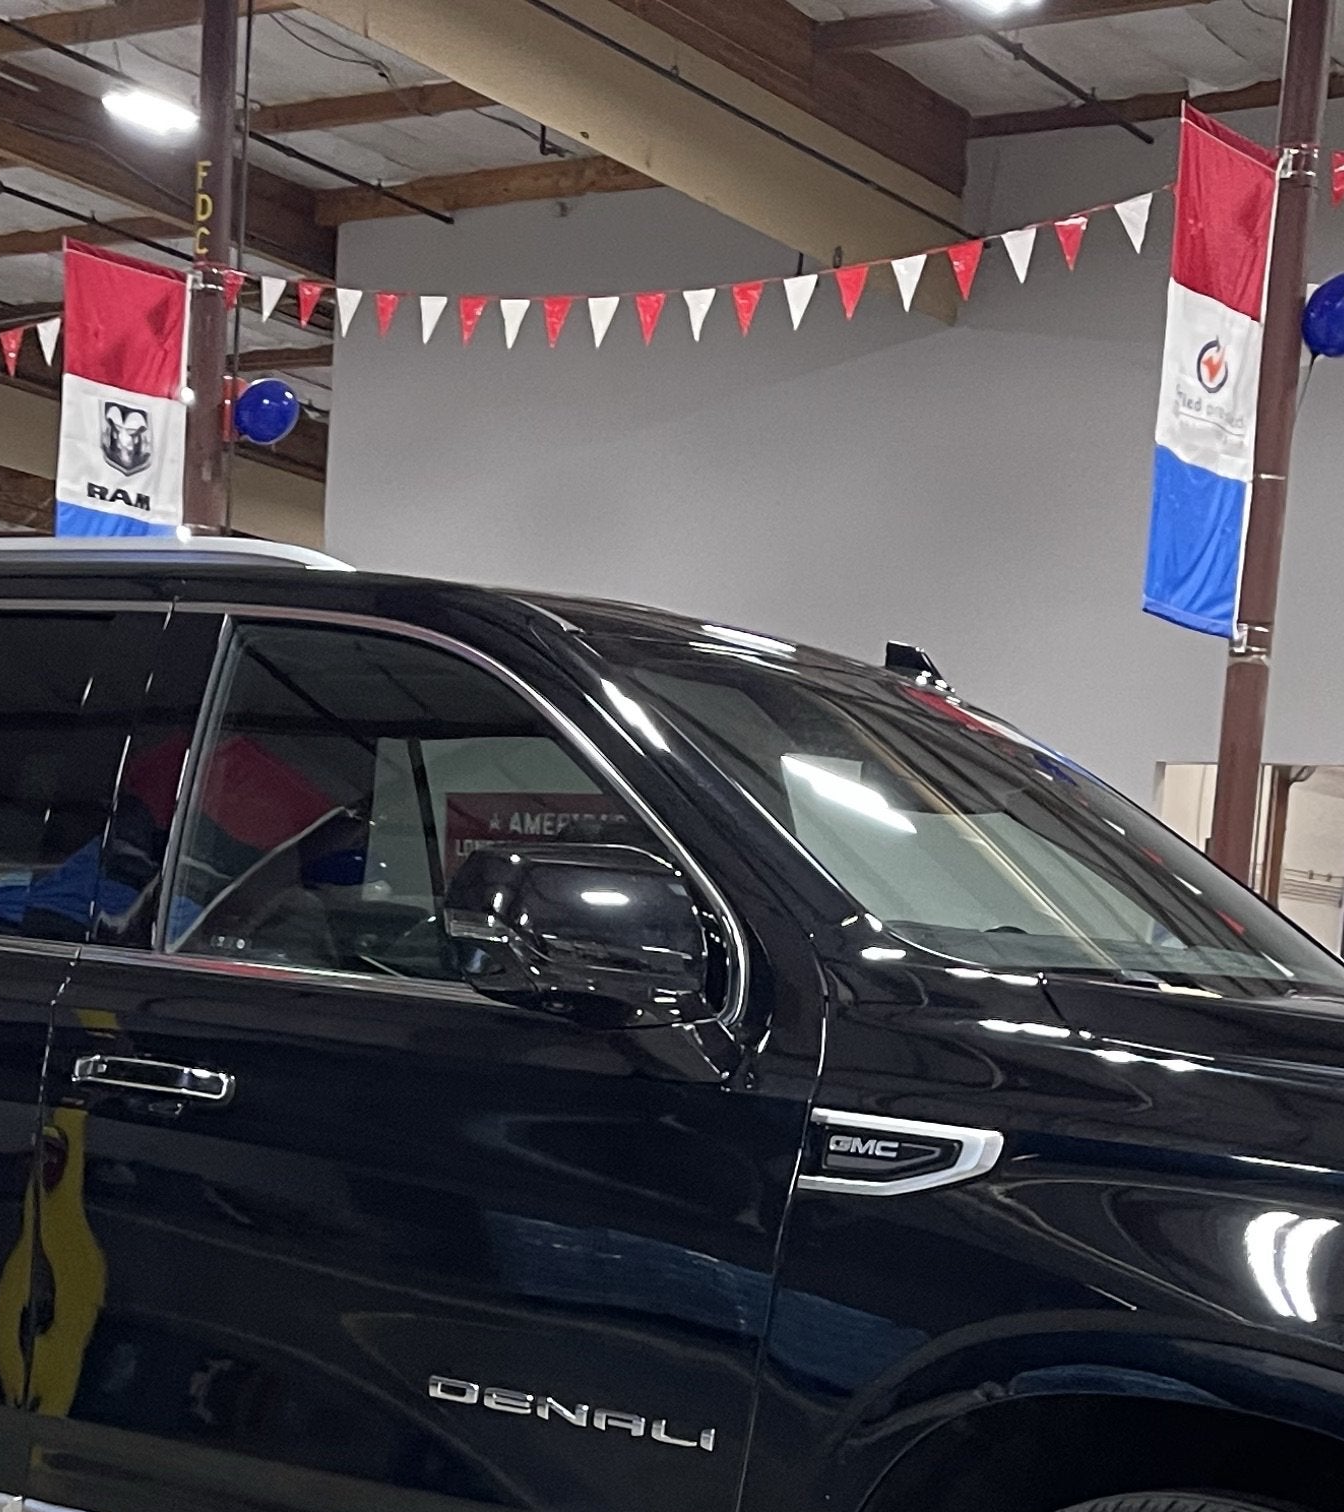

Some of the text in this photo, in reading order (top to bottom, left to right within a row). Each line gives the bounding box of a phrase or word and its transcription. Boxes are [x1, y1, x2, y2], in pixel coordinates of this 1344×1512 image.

[196, 160, 213, 254] FDC
[87, 482, 151, 512] RAM
[828, 1134, 899, 1158] GMC
[428, 1374, 716, 1452] DENALI
